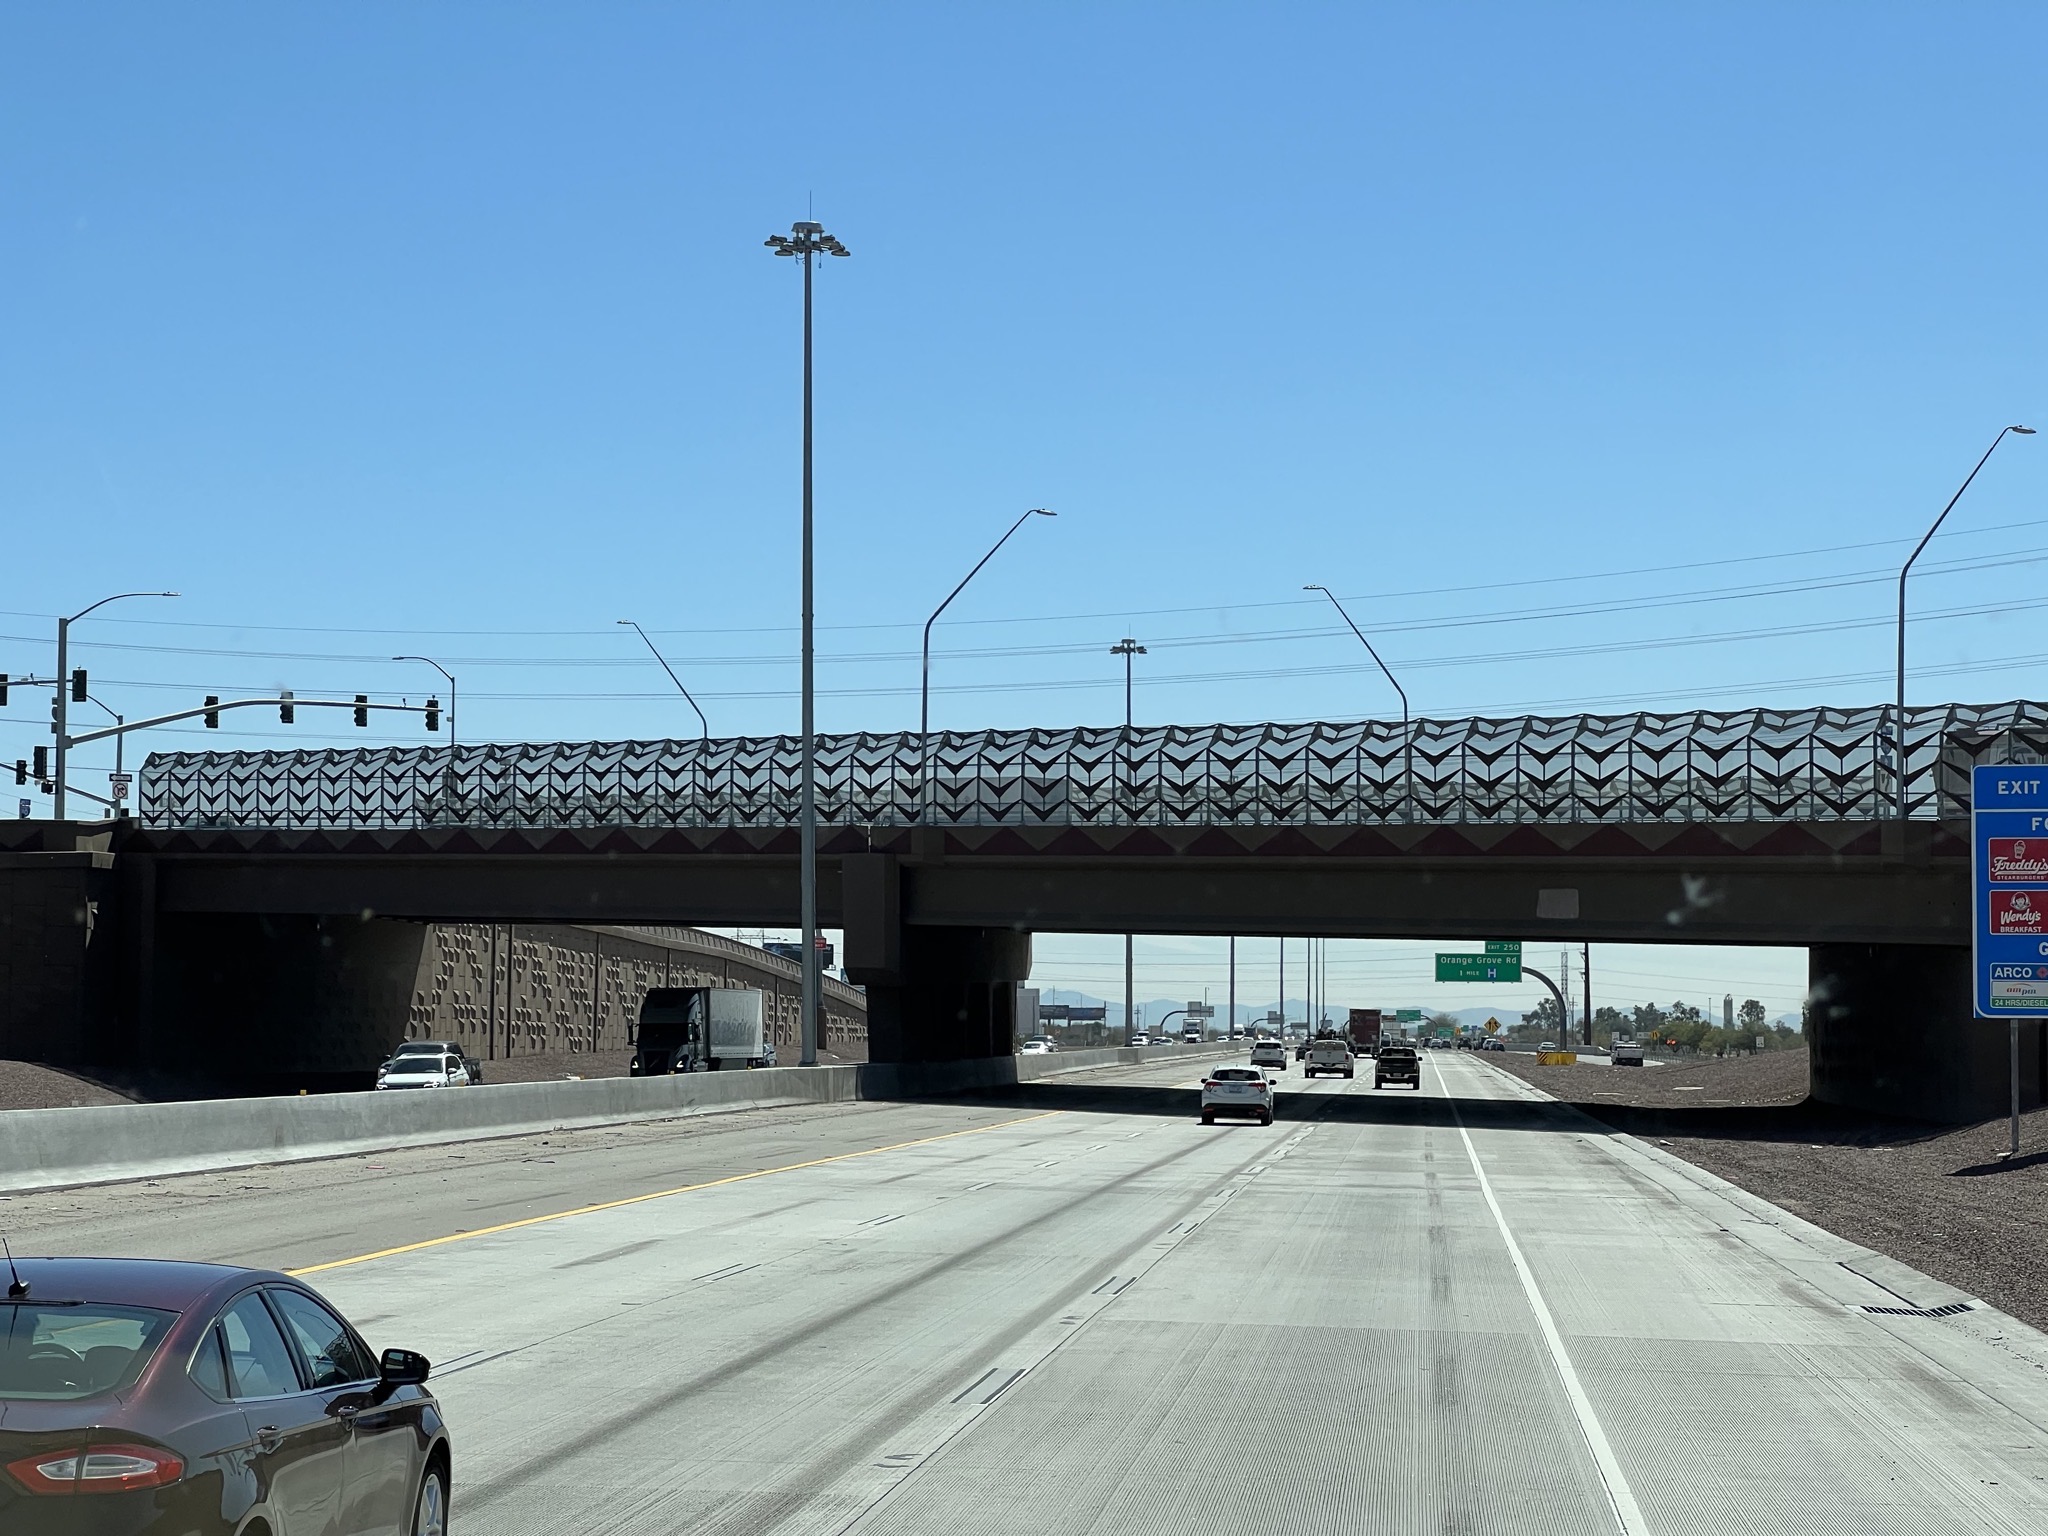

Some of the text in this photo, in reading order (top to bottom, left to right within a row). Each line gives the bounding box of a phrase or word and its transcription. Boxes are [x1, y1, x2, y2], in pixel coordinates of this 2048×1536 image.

[1998, 781, 2040, 794] EXIT
[1991, 856, 2048, 875] Freddy's
[2000, 909, 2042, 925] Wendy's
[1440, 956, 1517, 965] Orange Grove Rd
[1487, 968, 1497, 978] H
[1994, 967, 2032, 978] ARCO
[2006, 987, 2037, 996] ampm
